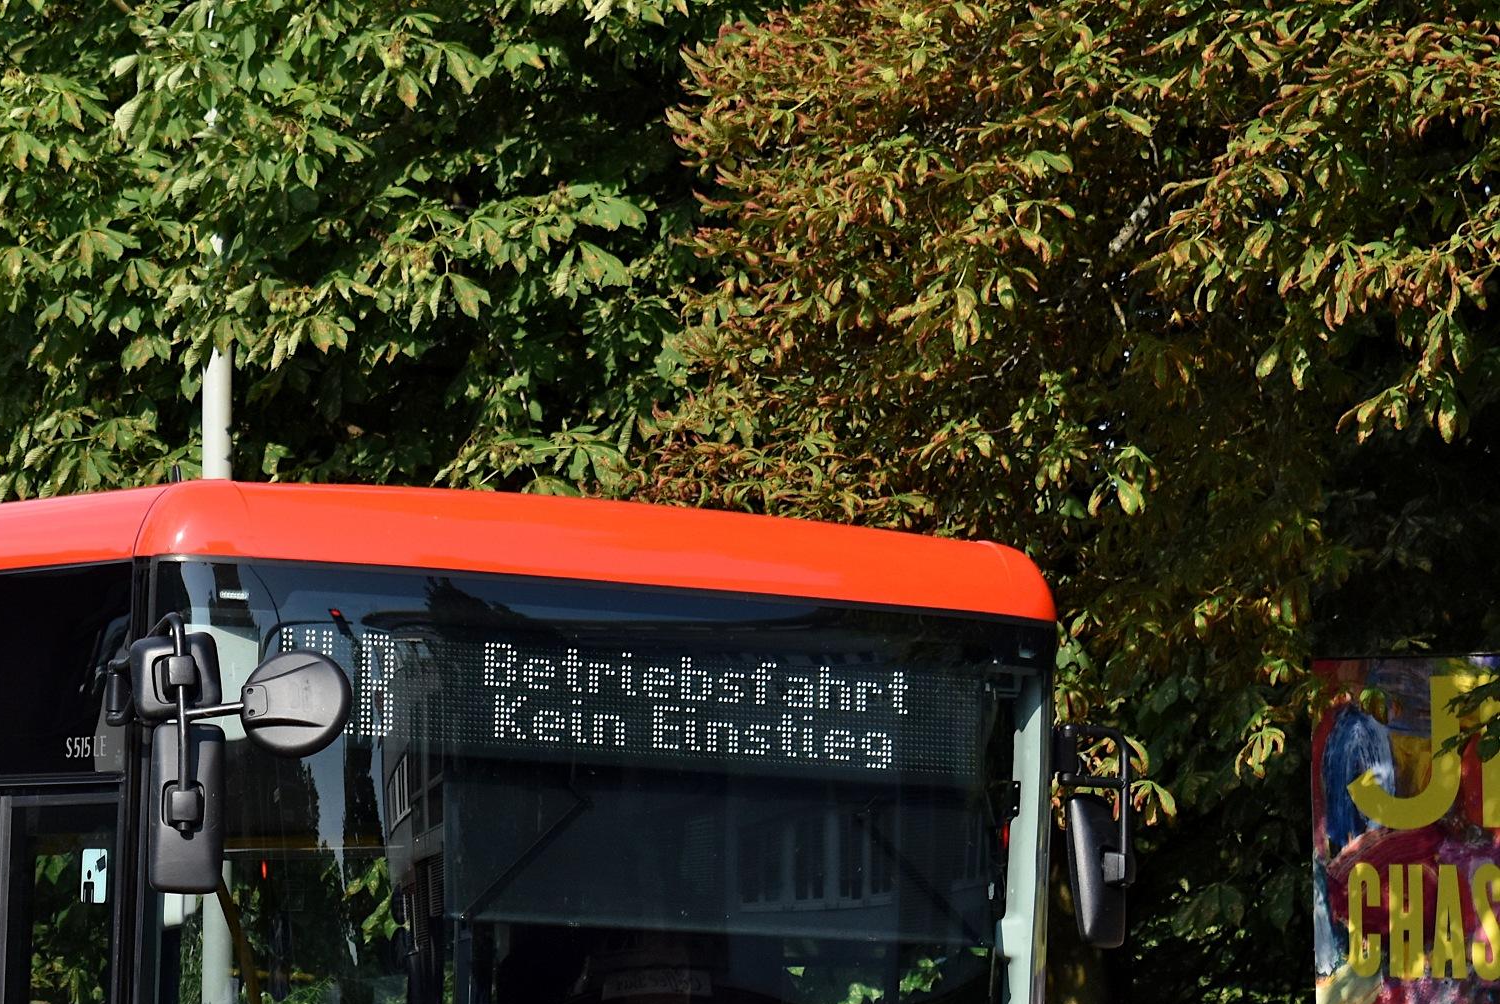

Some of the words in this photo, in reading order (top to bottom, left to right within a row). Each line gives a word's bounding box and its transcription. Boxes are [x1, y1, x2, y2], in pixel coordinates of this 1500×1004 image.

[485, 642, 908, 715] Betriebsfahrt
[494, 694, 626, 746] Kein
[652, 705, 892, 770] Einstieg
[1348, 861, 1500, 981] CHAS
